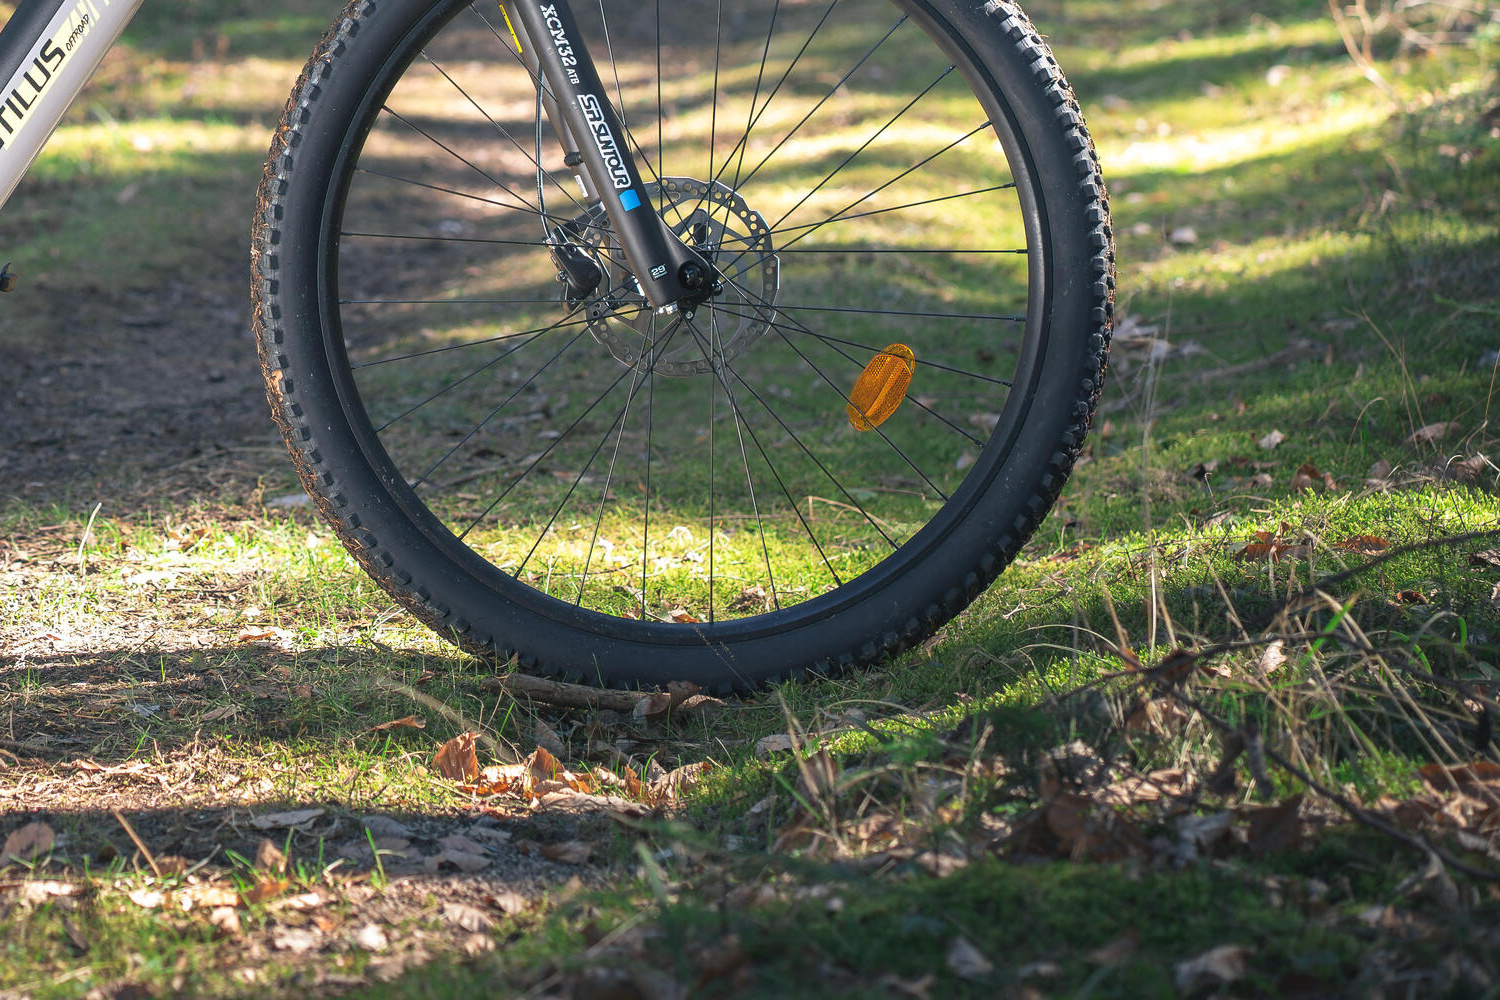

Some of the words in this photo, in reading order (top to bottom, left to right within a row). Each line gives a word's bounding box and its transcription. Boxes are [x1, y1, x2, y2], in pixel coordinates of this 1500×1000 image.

[65, 13, 90, 51] OFFROAD
[540, 3, 577, 67] XCM32
[566, 68, 580, 85] ATB
